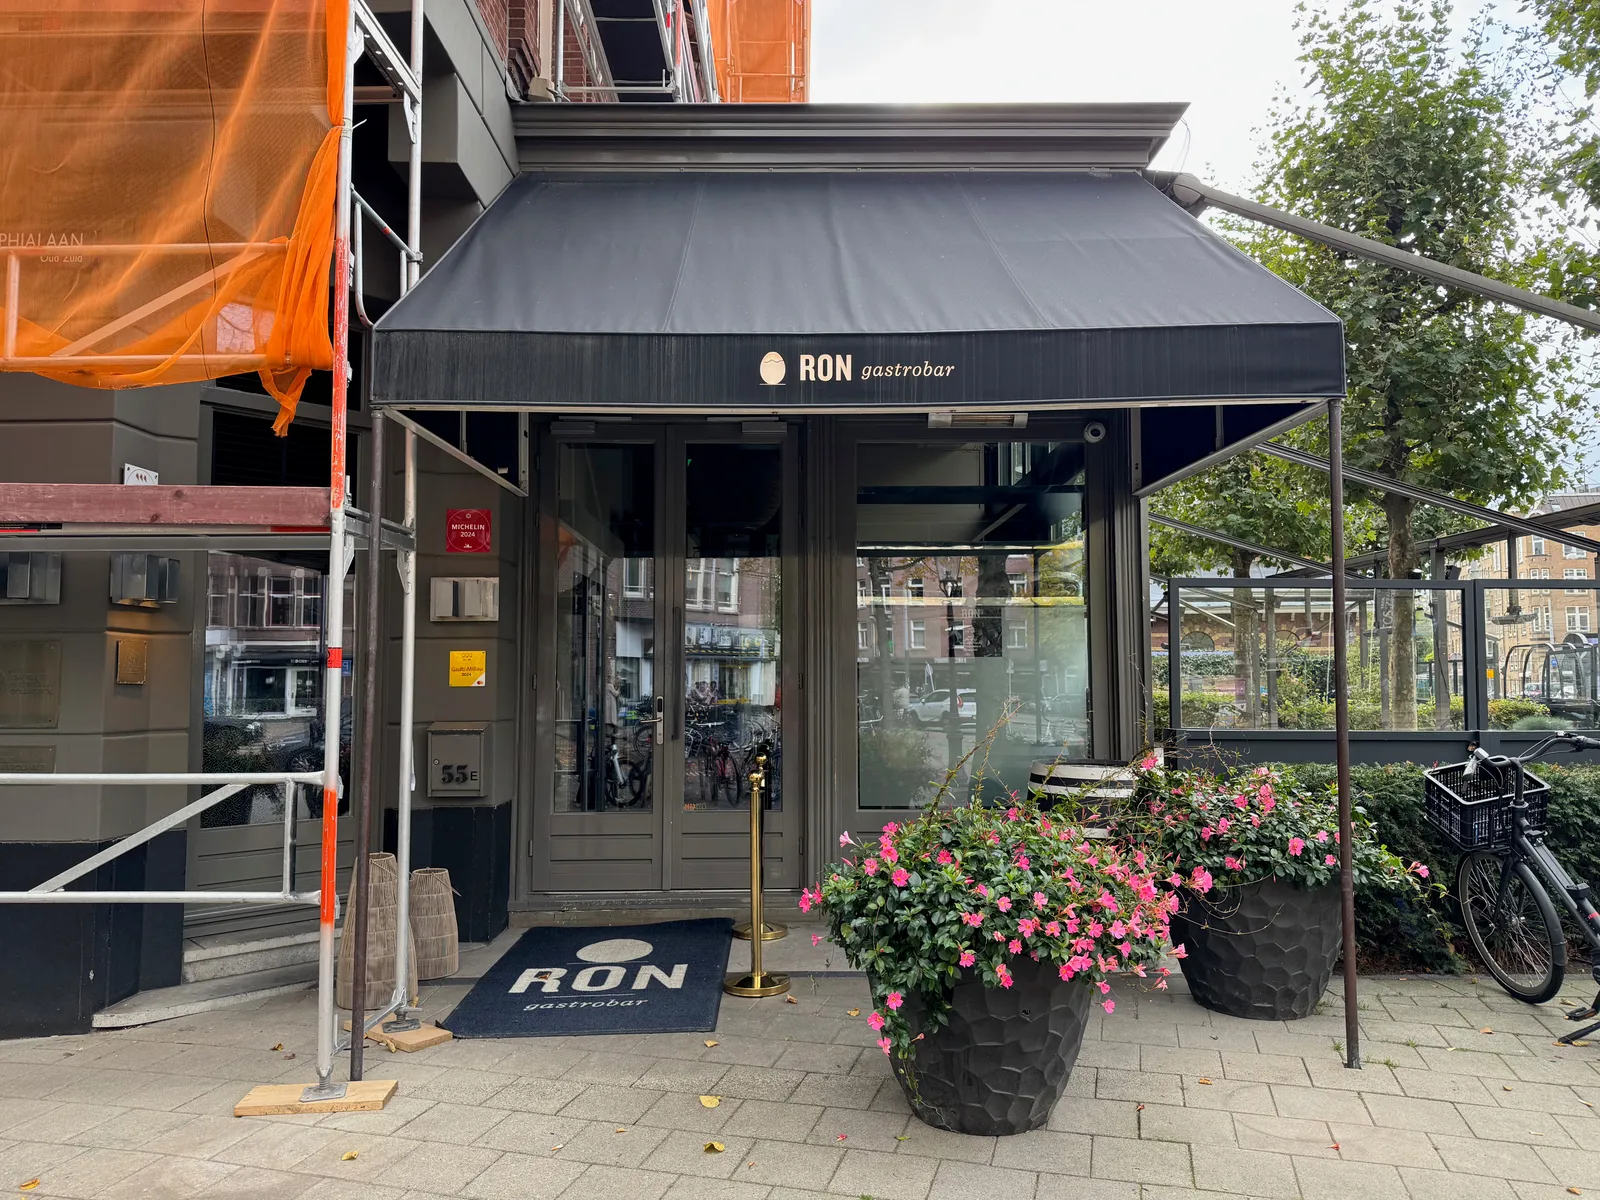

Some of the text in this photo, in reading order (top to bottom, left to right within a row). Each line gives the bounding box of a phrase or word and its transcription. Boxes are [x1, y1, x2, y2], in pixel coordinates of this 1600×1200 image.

[799, 353, 955, 382] RON gastrobar
[440, 764, 478, 784] 55 E
[508, 963, 689, 994] RON
[522, 999, 649, 1011] gastrobar
